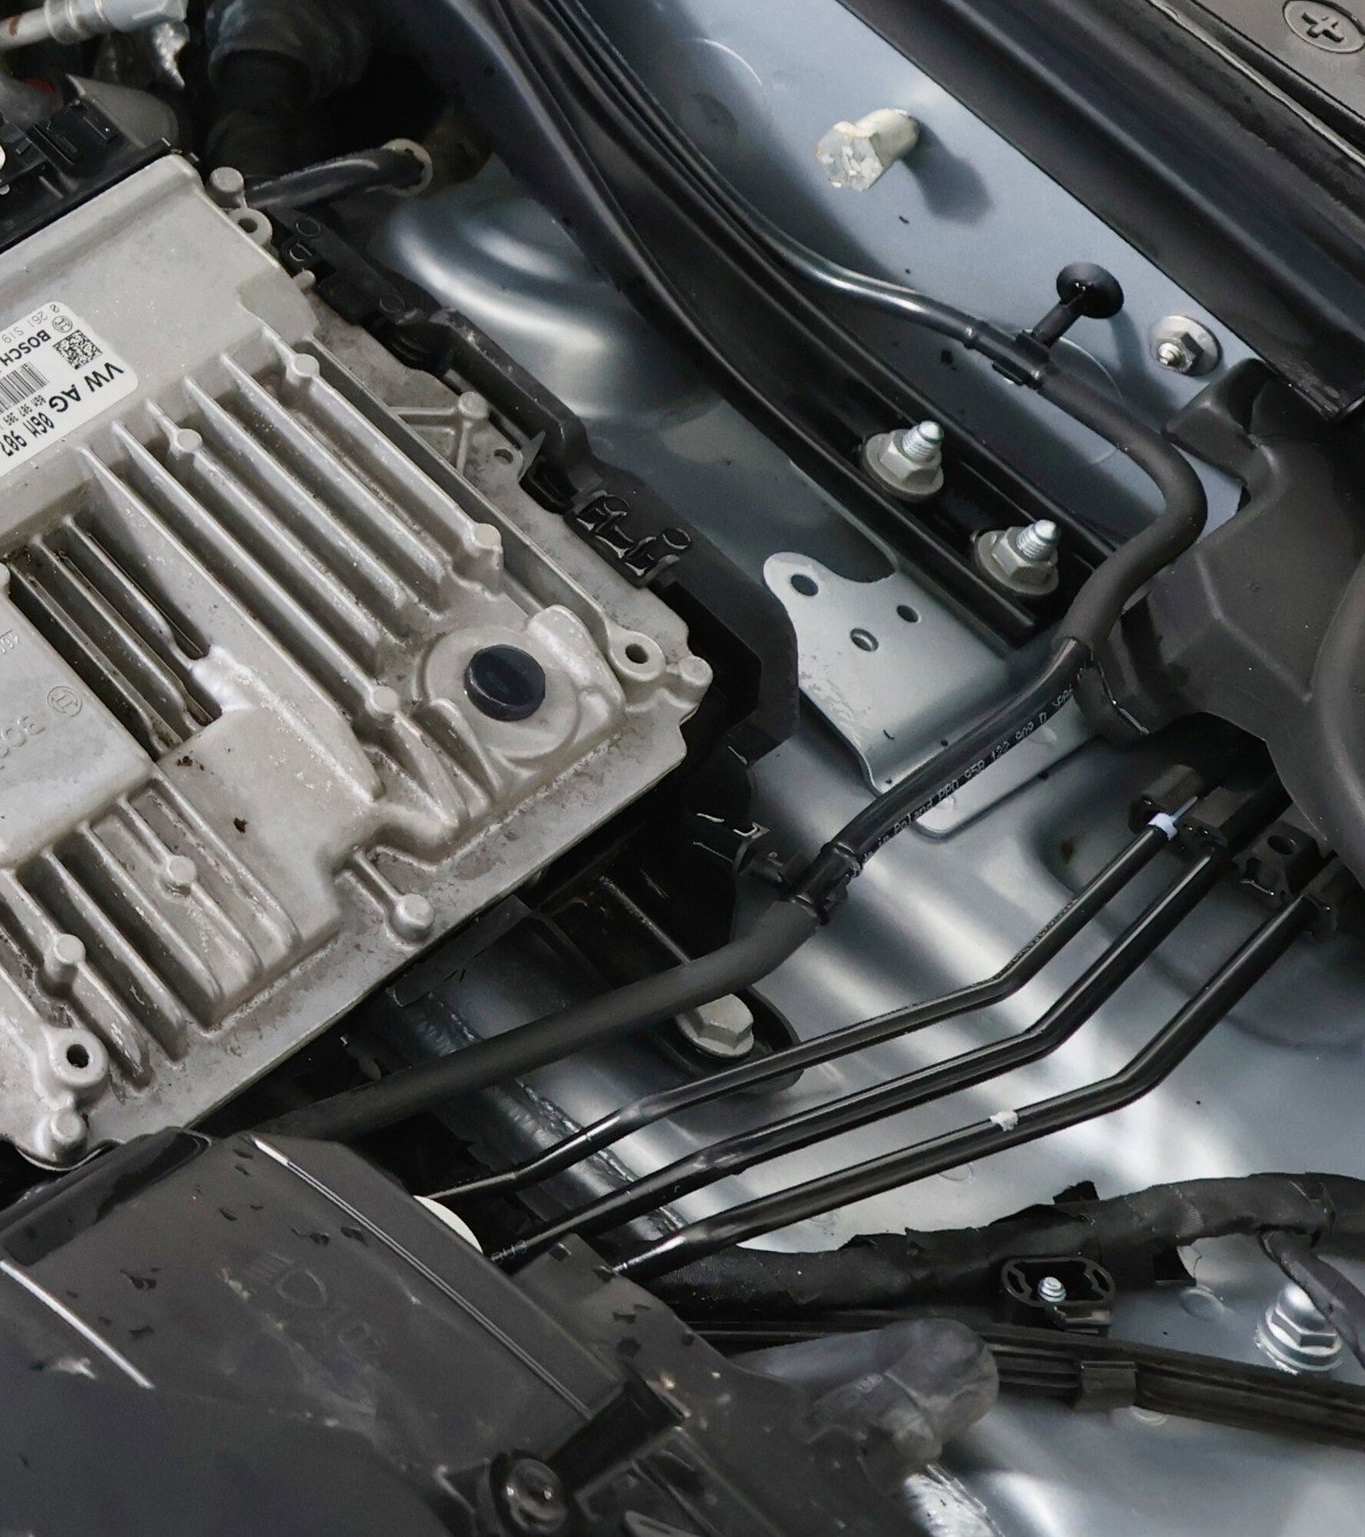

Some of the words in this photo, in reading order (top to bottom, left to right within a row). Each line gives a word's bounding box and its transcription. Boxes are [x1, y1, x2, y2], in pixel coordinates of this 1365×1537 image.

[25, 310, 48, 329] 261
[83, 362, 125, 393] VW
[28, 393, 46, 409] 06M
[46, 382, 79, 413] AG
[14, 402, 32, 418] 907
[21, 410, 55, 440] 06M
